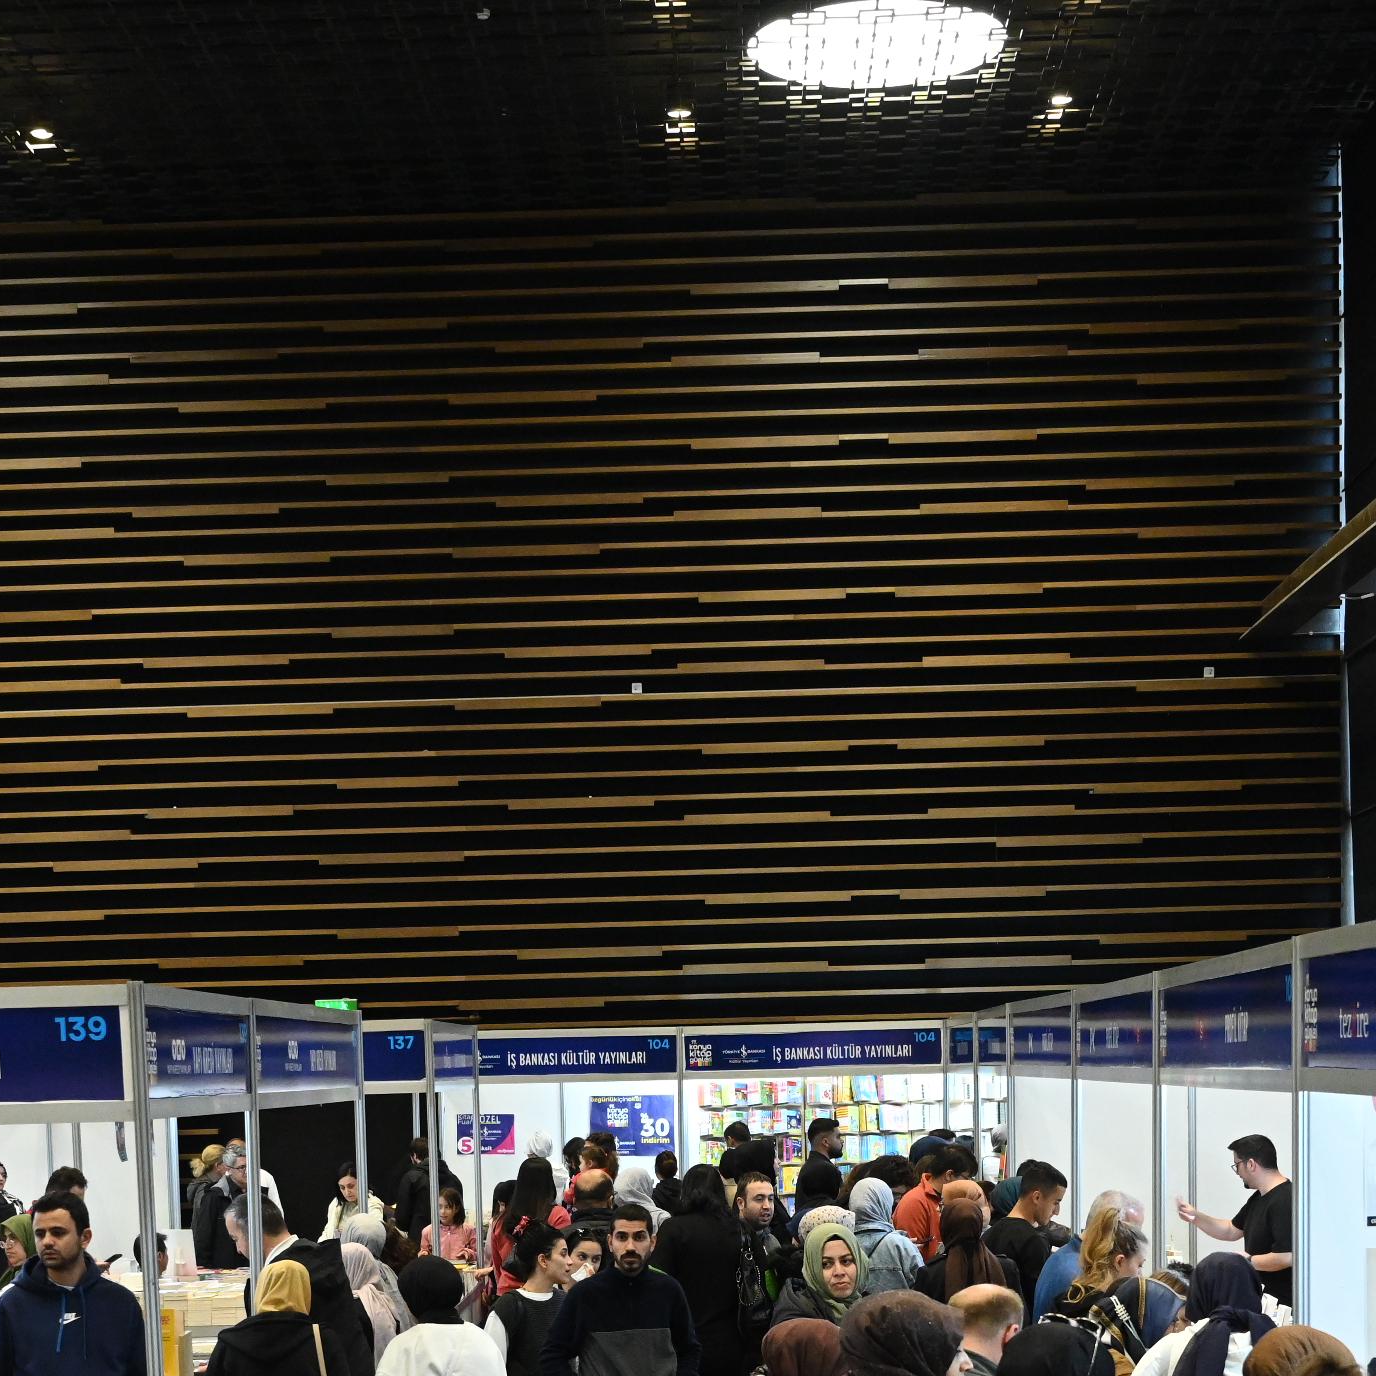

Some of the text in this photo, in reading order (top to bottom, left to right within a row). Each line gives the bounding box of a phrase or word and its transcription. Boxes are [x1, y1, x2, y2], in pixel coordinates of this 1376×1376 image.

[54, 1015, 108, 1043] 139
[387, 1036, 415, 1050] 137
[913, 1031, 936, 1043] 104
[647, 1038, 671, 1051] 104
[689, 1044, 712, 1052] konya
[507, 1049, 647, 1069] İŞ BANKASI KÜLTÜR YAYINLARI
[689, 1050, 712, 1058] kitap
[772, 1043, 912, 1064] İŞ BANKASI KÜLTÜR YAYINLARI
[461, 1139, 473, 1153] 5
